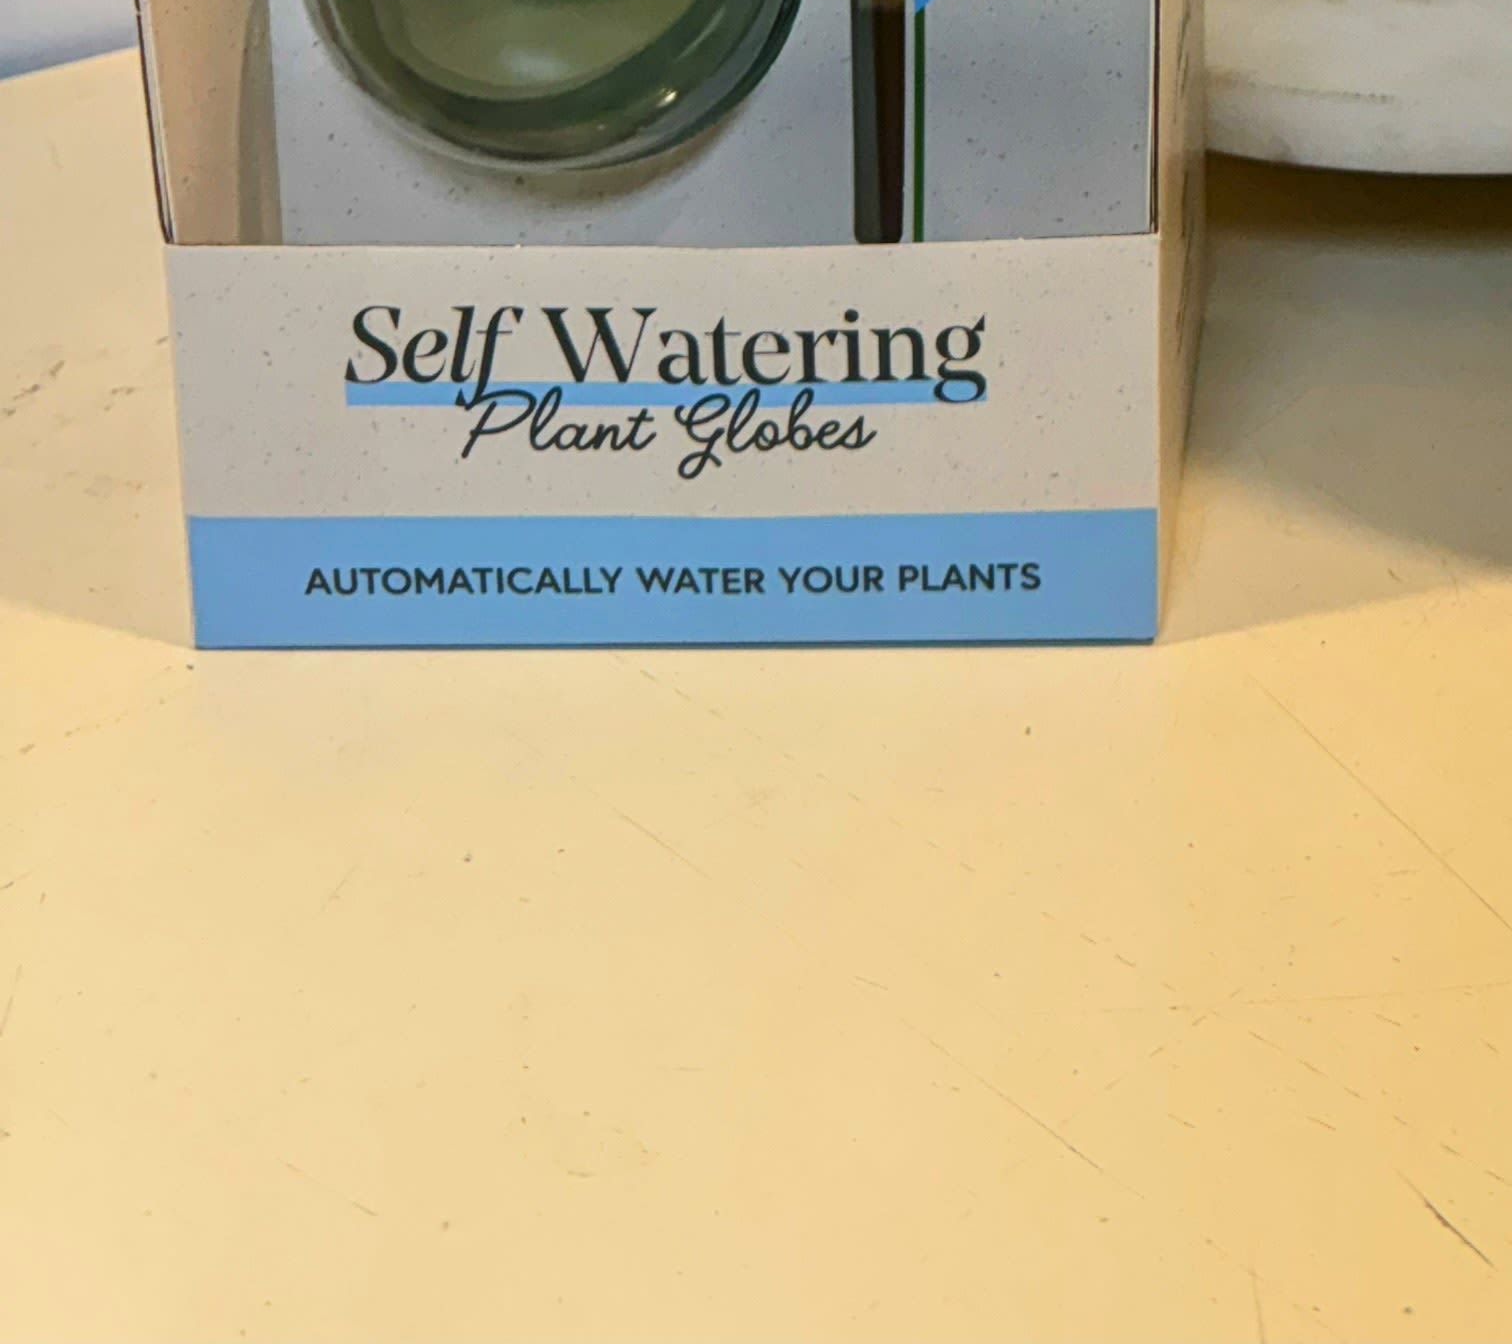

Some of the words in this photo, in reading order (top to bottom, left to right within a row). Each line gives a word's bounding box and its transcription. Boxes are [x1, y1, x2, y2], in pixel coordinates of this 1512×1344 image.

[346, 305, 524, 407] Self
[540, 308, 987, 403] Watering
[461, 389, 657, 459] Plant
[674, 389, 877, 479] Globes
[305, 566, 622, 597] AUTOMATICALLY
[637, 565, 766, 596] WATER
[778, 564, 884, 594] YOUR
[899, 562, 1041, 593] PLANTS
